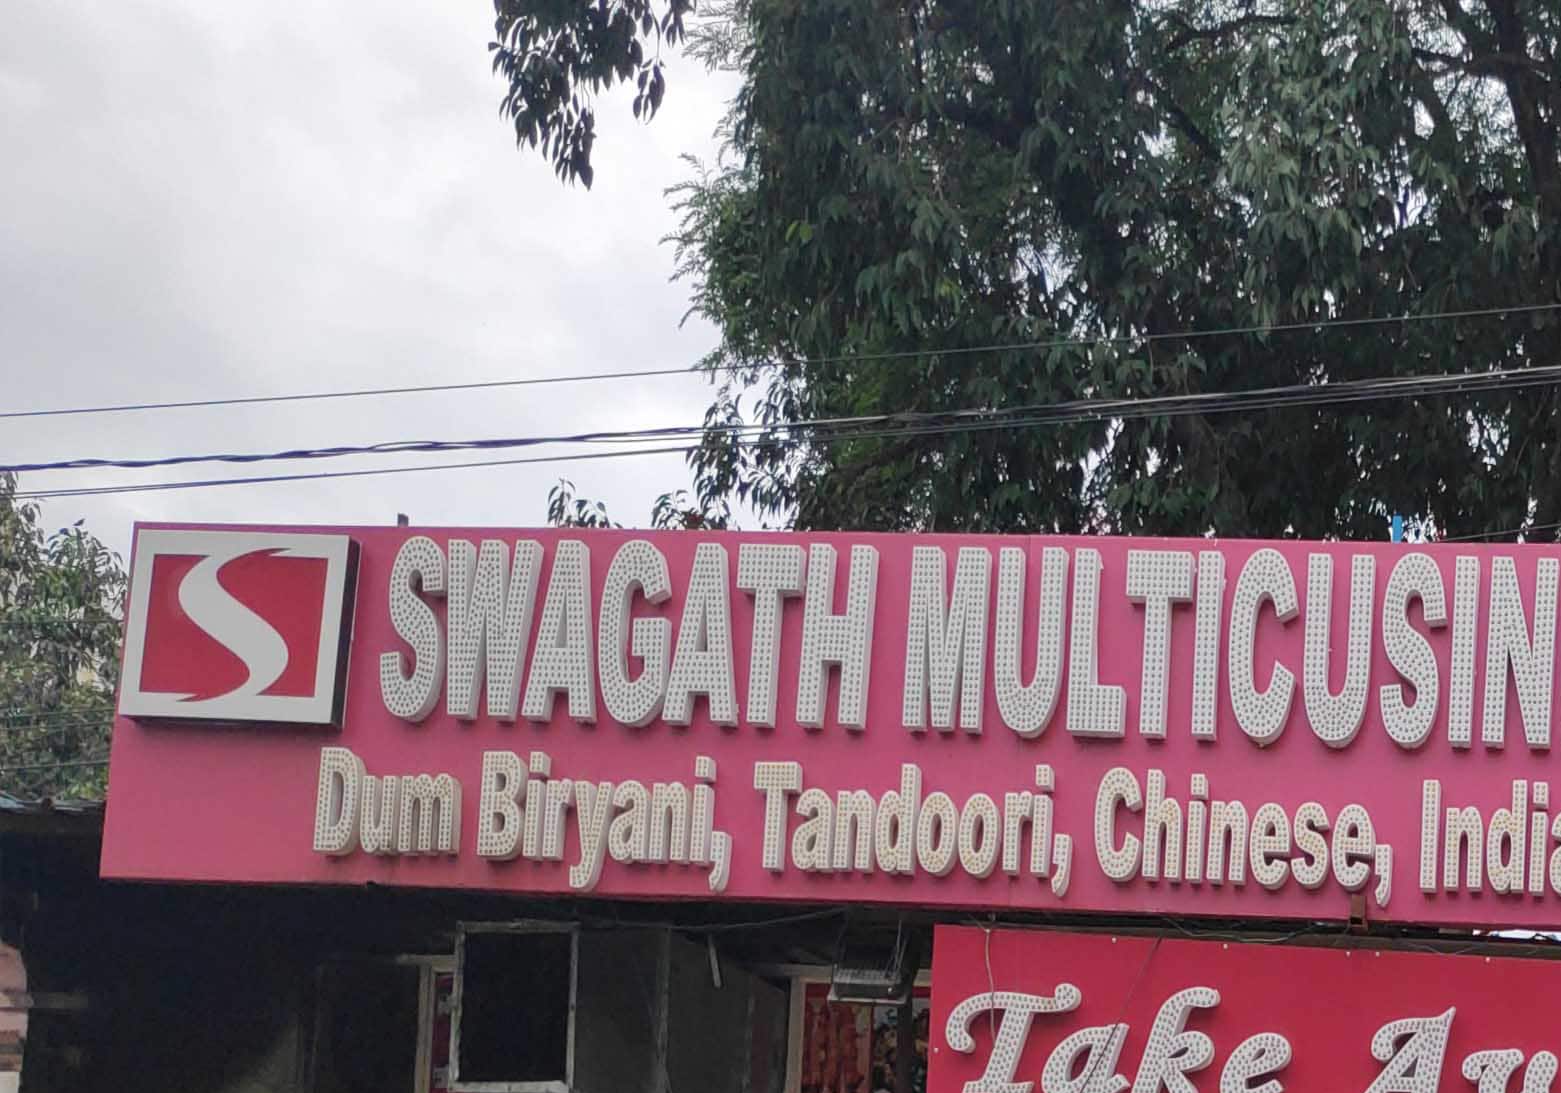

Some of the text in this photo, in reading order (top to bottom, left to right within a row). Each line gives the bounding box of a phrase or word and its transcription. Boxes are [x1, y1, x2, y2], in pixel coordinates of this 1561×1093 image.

[380, 536, 878, 731] SWAGATH
[312, 747, 462, 857] Dum
[477, 751, 734, 893] Biryani,
[754, 761, 1074, 897] Tandoori,
[1094, 767, 1393, 906] Chinese,
